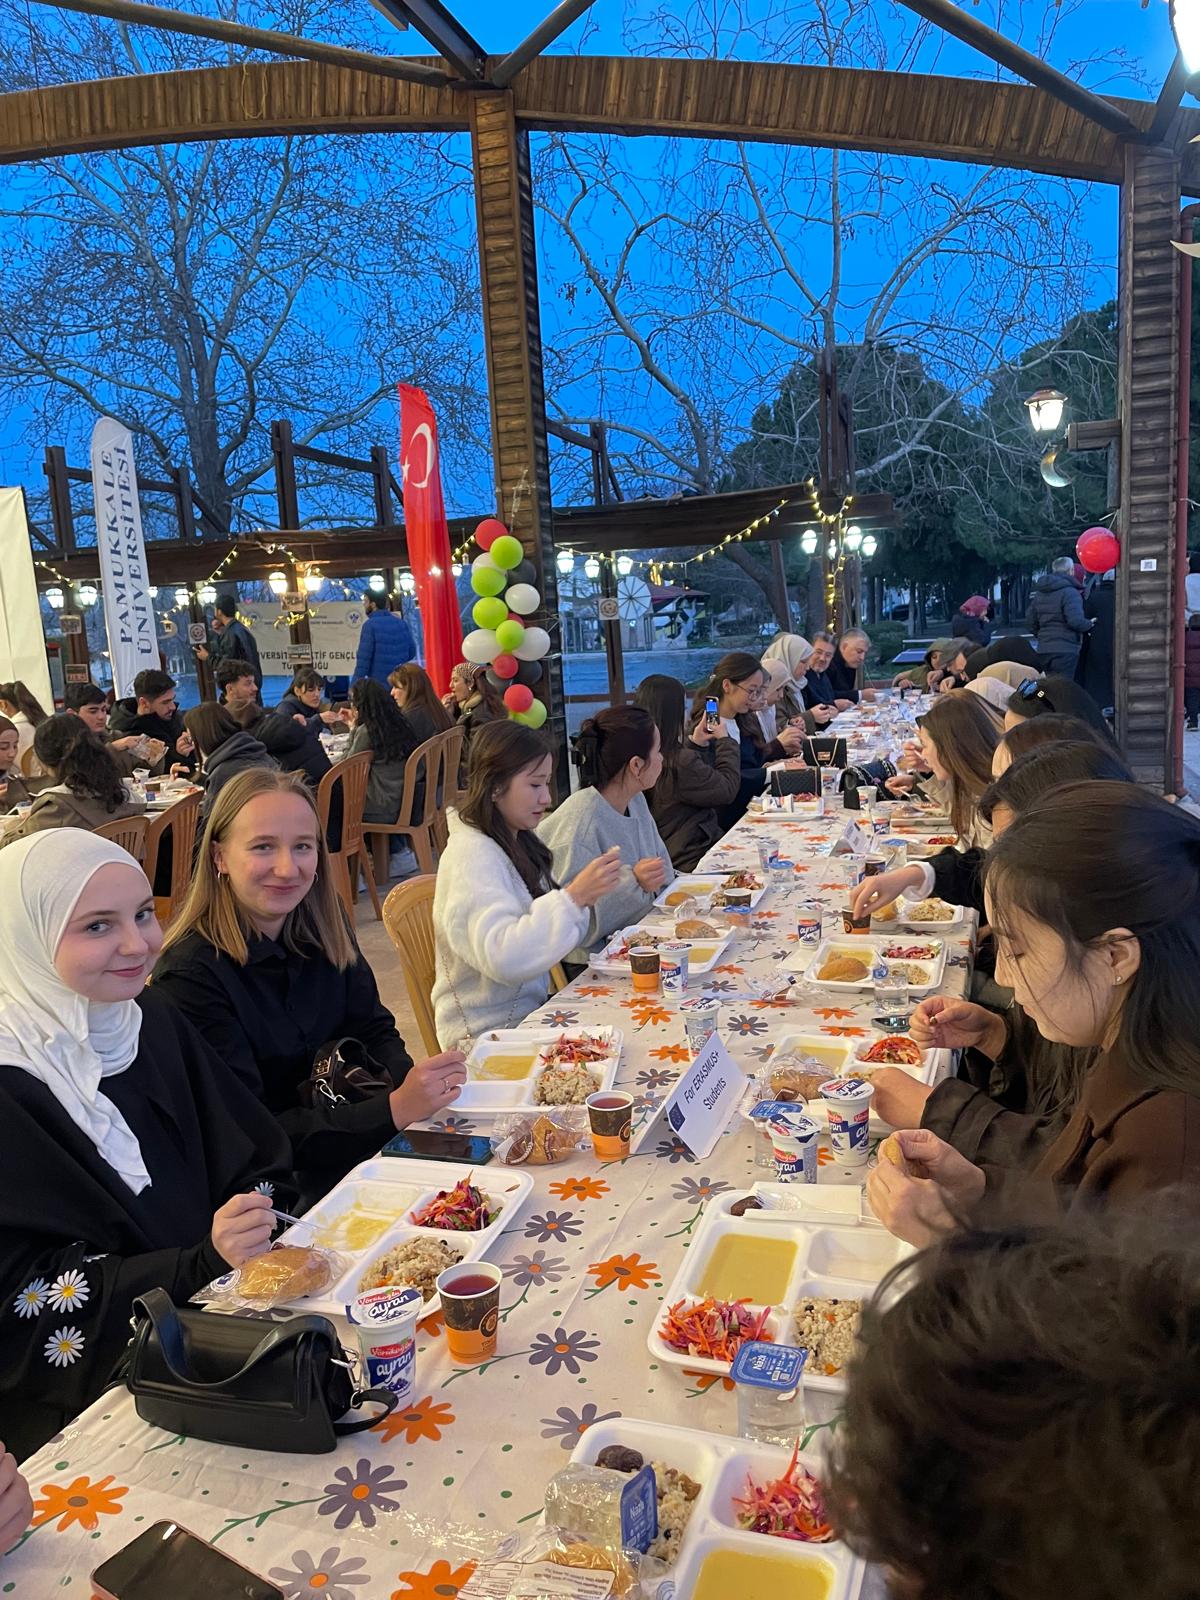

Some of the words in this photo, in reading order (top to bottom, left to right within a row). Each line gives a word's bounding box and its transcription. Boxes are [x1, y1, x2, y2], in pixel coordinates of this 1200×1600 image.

[102, 450, 133, 644] PAMUKKALE
[114, 447, 153, 655] ÜNİVERSİTESİ
[329, 650, 355, 661] GENÇL
[683, 1086, 695, 1104] For
[692, 1050, 719, 1093] ERASMUS+
[703, 1077, 727, 1110] Students
[777, 1163, 796, 1178] yran
[369, 1294, 409, 1318] ayran
[376, 1351, 411, 1384] ayran
